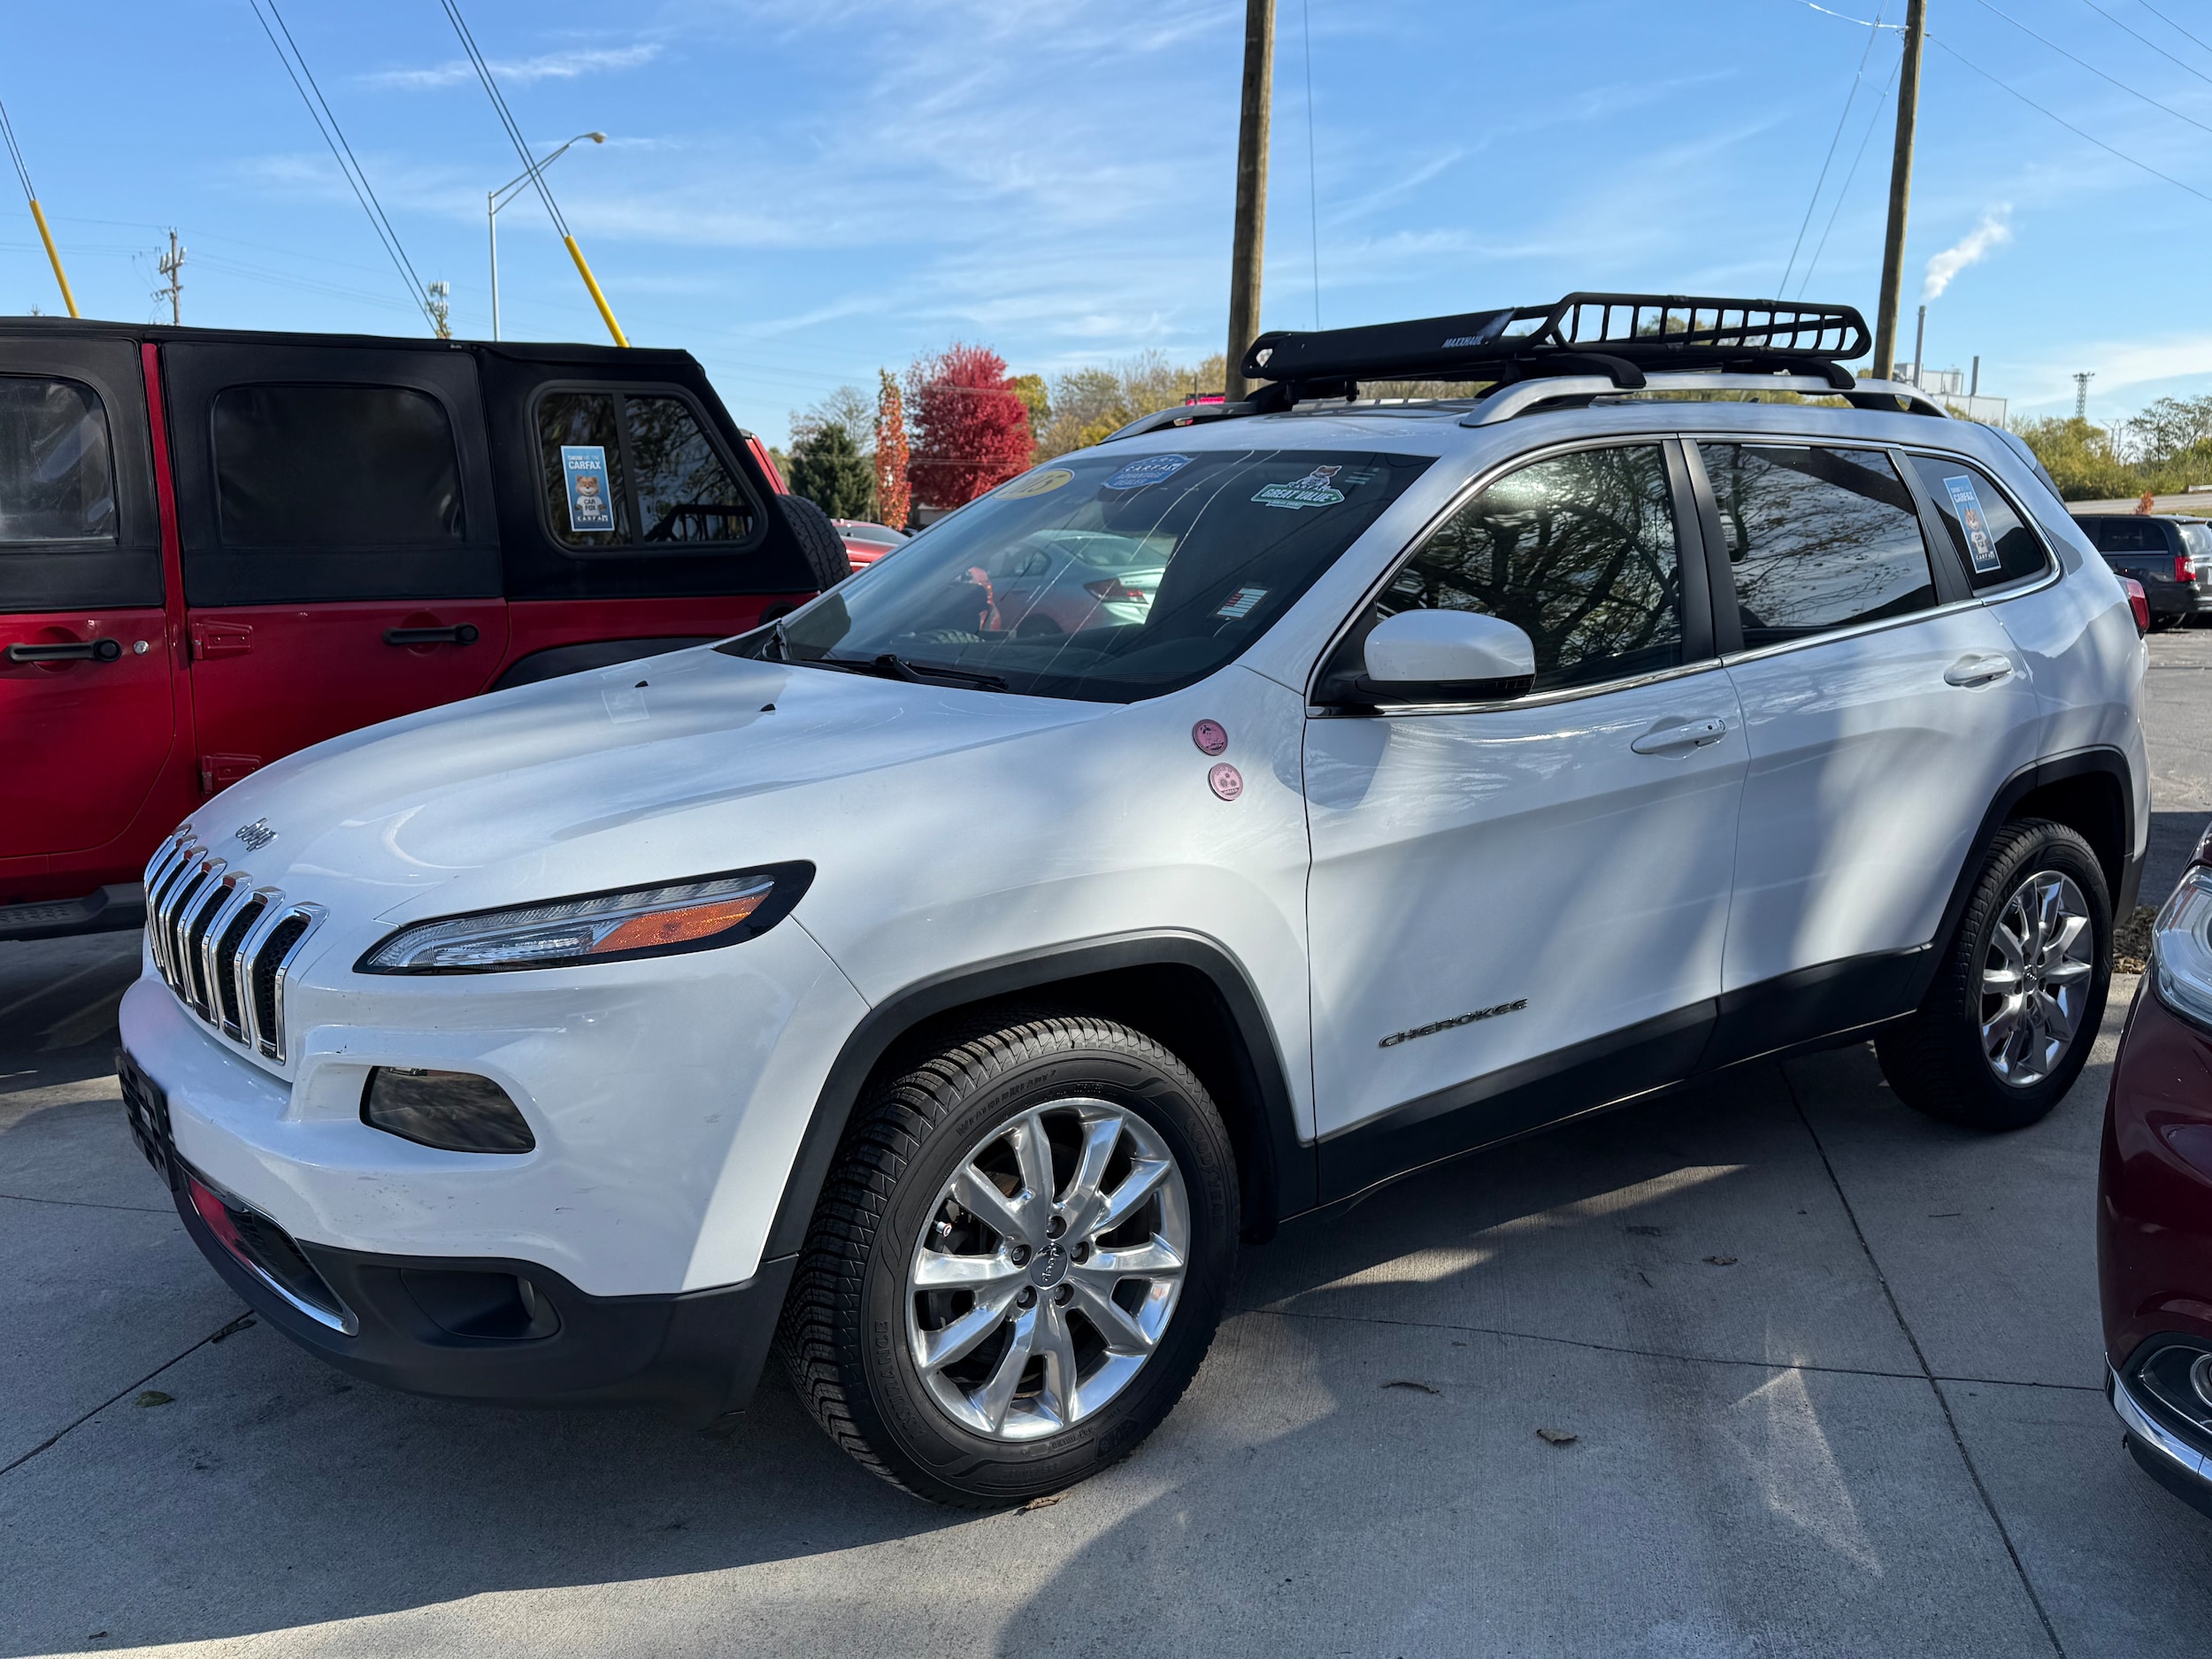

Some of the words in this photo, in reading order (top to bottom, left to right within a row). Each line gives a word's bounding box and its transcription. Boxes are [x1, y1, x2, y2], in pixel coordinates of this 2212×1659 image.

[1441, 336, 1484, 349] MAXXHAUL
[568, 461, 602, 470] CARFAX
[1125, 462, 1183, 472] CARFAX
[1287, 483, 1331, 492] CARFAX
[1261, 488, 1300, 499] GREAT
[1294, 490, 1333, 503] VALUE
[1953, 492, 1974, 503] CARFAX
[235, 818, 279, 852] Jeep
[1379, 997, 1529, 1048] CHEROKEE
[1184, 1118, 1224, 1229] GOODYEAR
[874, 1319, 926, 1439] ASSURANCE
